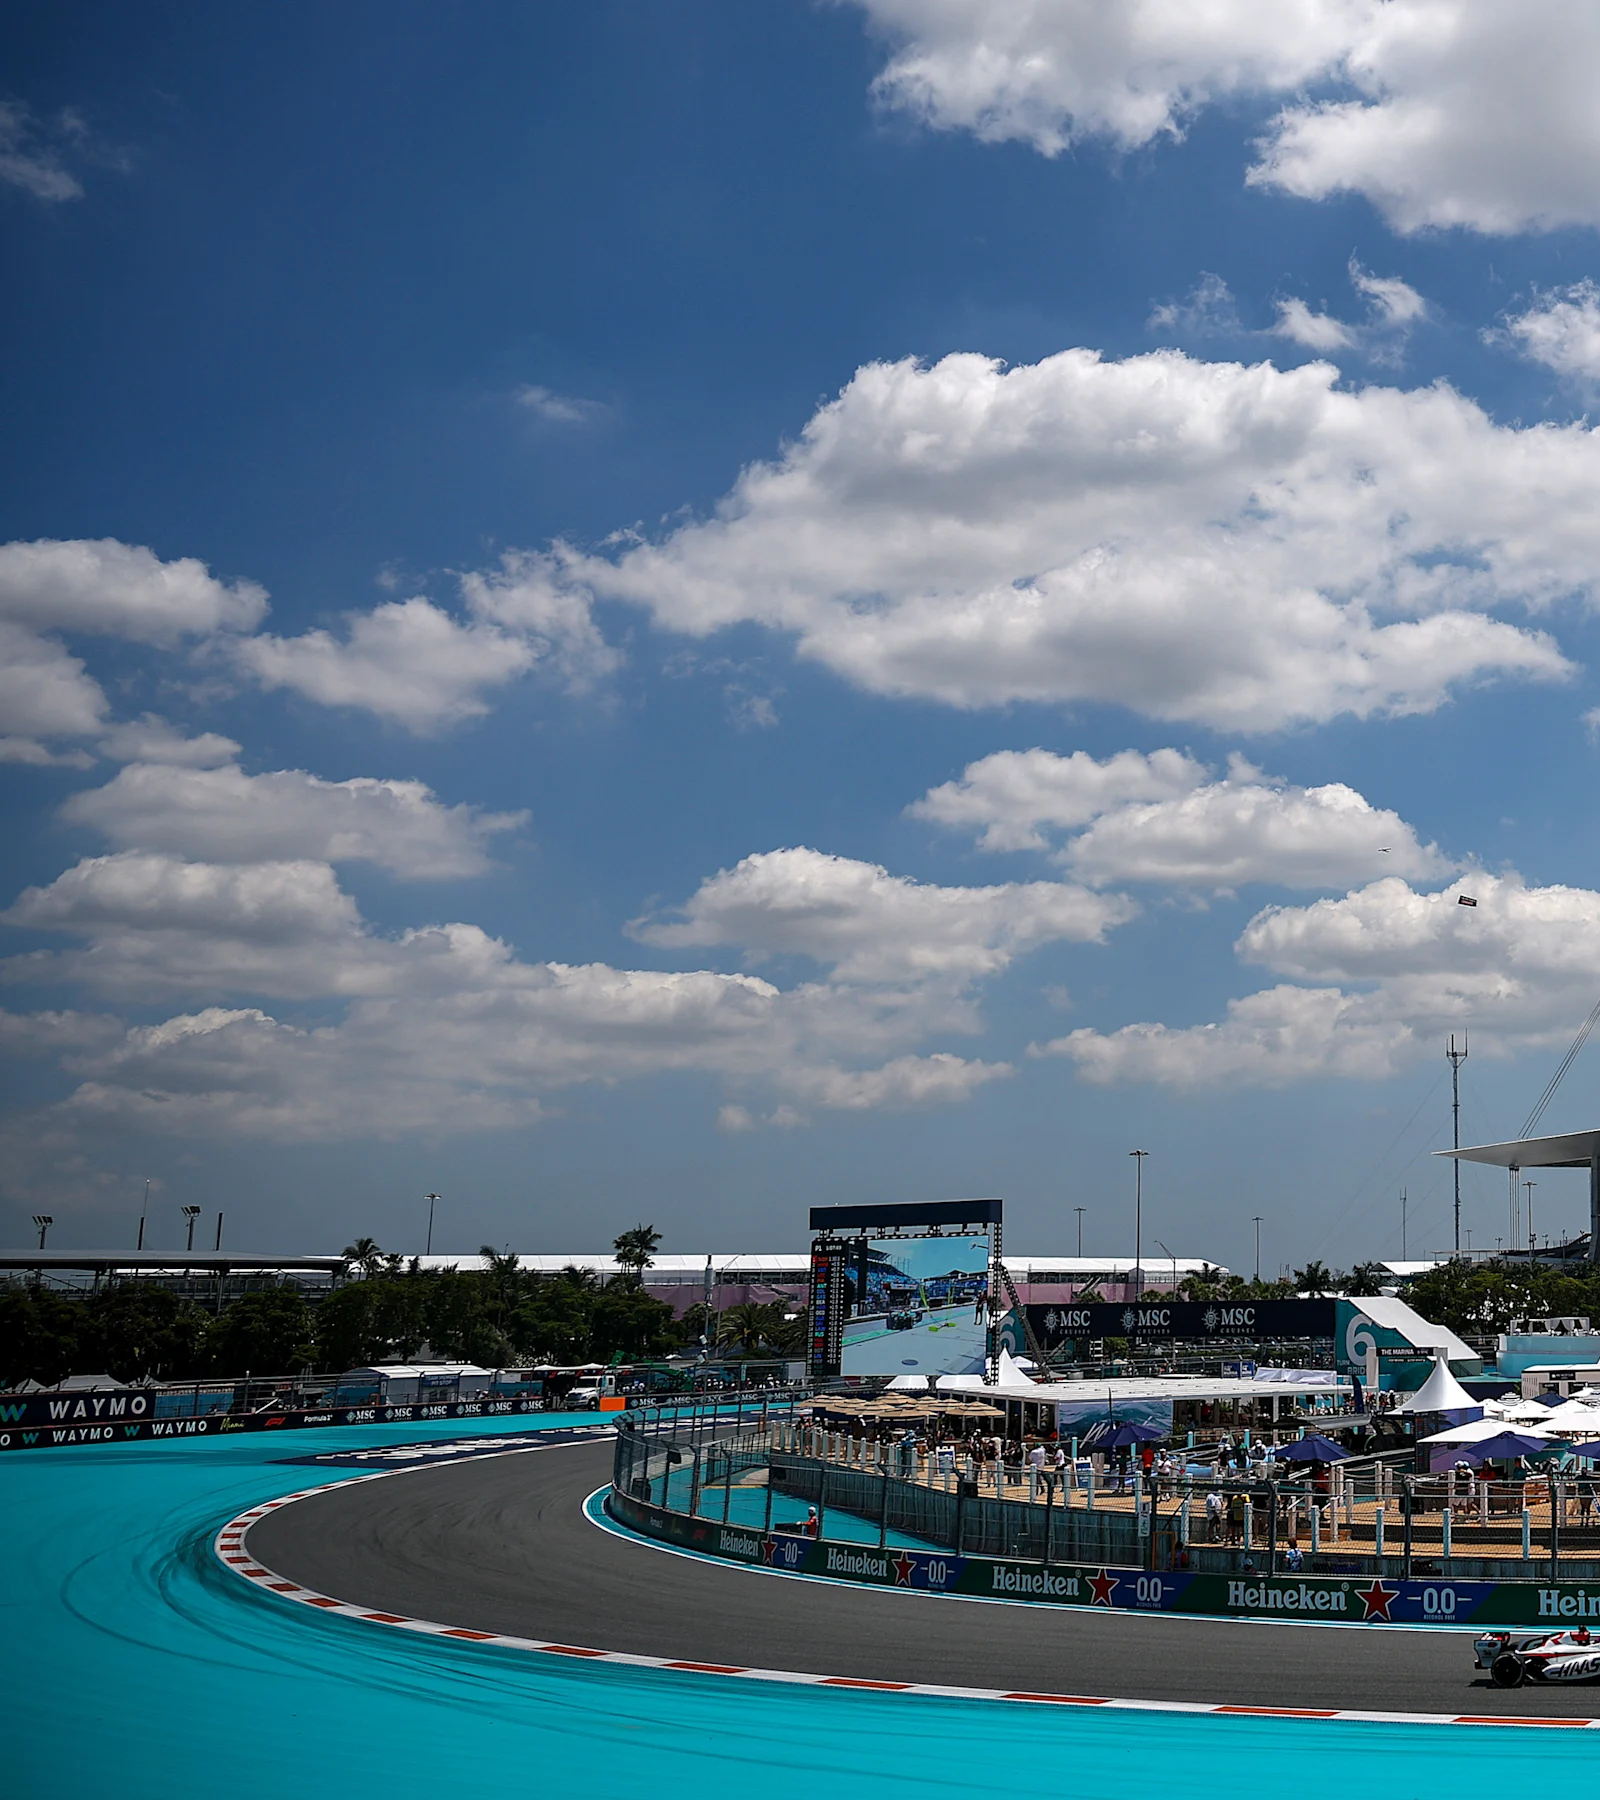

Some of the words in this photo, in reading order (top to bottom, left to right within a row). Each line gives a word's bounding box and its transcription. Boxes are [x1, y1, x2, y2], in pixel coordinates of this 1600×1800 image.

[1060, 1310, 1091, 1326] MSC
[1138, 1309, 1170, 1326] MSC
[1221, 1308, 1255, 1325] MSC
[1346, 1313, 1376, 1366] 6
[1347, 1367, 1366, 1375] BRID
[49, 1396, 147, 1420] WAYMO
[465, 1404, 482, 1413] MSC
[495, 1402, 512, 1411] MSC
[640, 1398, 657, 1406] MSC
[356, 1410, 376, 1420] MSC
[394, 1407, 412, 1417] MSC
[428, 1405, 447, 1415] MSC
[53, 1427, 113, 1442] WAYMO
[152, 1420, 207, 1435] WAYMO
[720, 1530, 759, 1557] Heineken
[826, 1548, 888, 1577] Heineken
[992, 1566, 1079, 1597] Heineken
[1228, 1581, 1348, 1611] Heineken
